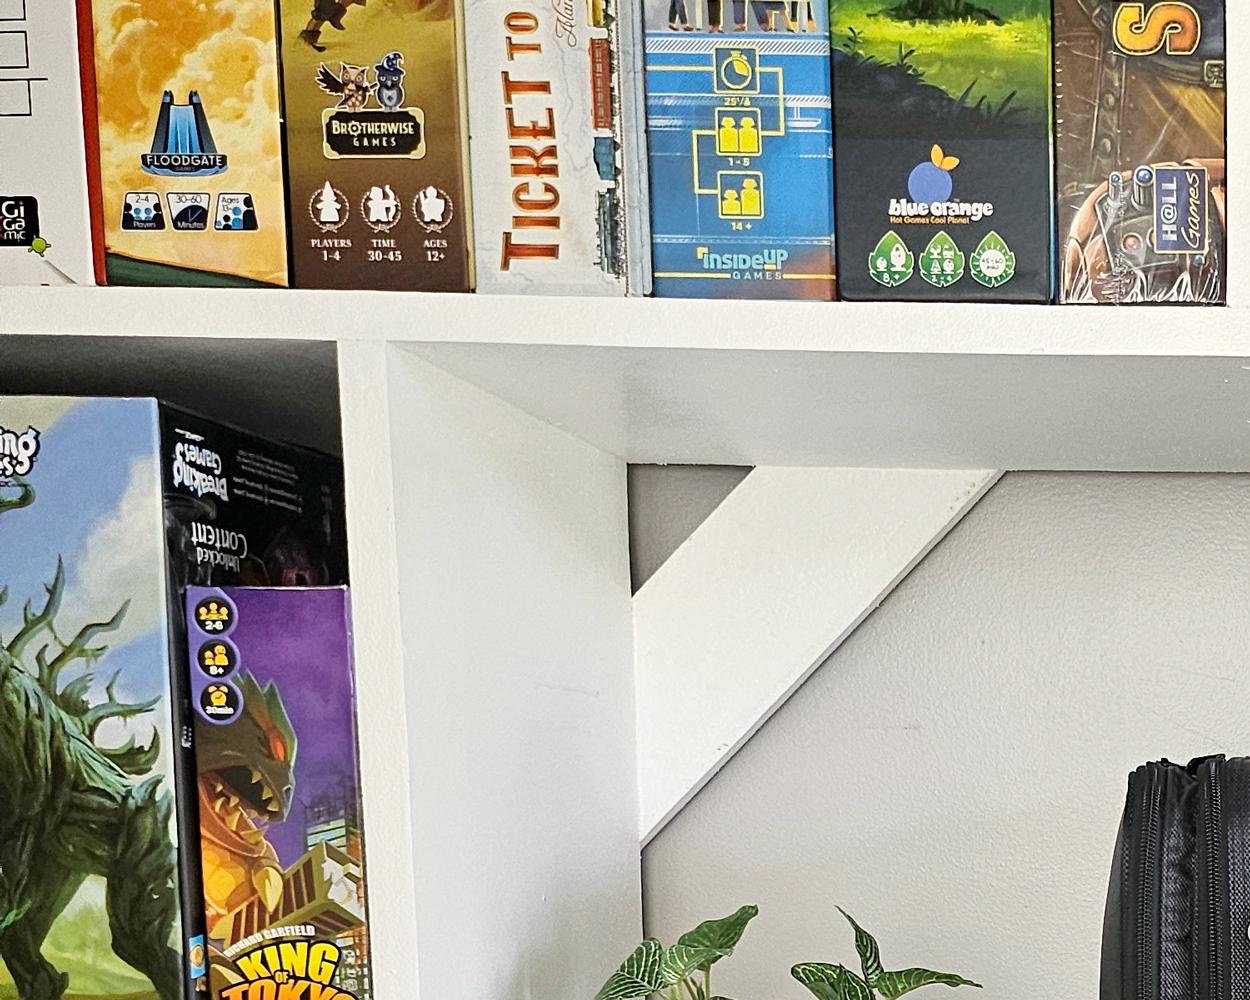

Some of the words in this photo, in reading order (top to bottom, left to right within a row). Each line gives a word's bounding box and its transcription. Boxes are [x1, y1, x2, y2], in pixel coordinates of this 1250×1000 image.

[504, 11, 541, 62] TO
[332, 120, 415, 135] BROTHERWISE
[353, 137, 397, 147] GAMES
[146, 155, 223, 166] FLOODGATE
[500, 70, 560, 271] TICKET
[135, 195, 150, 204] 2-4
[175, 195, 203, 204] 30-60
[889, 199, 929, 216] blue
[930, 201, 993, 221] orange
[1163, 177, 1177, 241] H@LL
[1179, 171, 1201, 249] Games
[133, 221, 157, 229] Players
[177, 221, 205, 229] Minutes
[311, 239, 352, 248] PLAYERS
[370, 239, 397, 248] TIME
[423, 239, 448, 248] AGES
[322, 251, 341, 262] 1-4
[368, 251, 402, 262] 30-45
[427, 251, 445, 262] 12+
[732, 272, 781, 280] GAMES
[173, 461, 229, 502] Breaking
[191, 522, 247, 559] Content
[223, 932, 264, 957] RICHARD
[263, 925, 315, 940] GARFIELD
[236, 942, 339, 985] KING
[275, 972, 289, 984] OF
